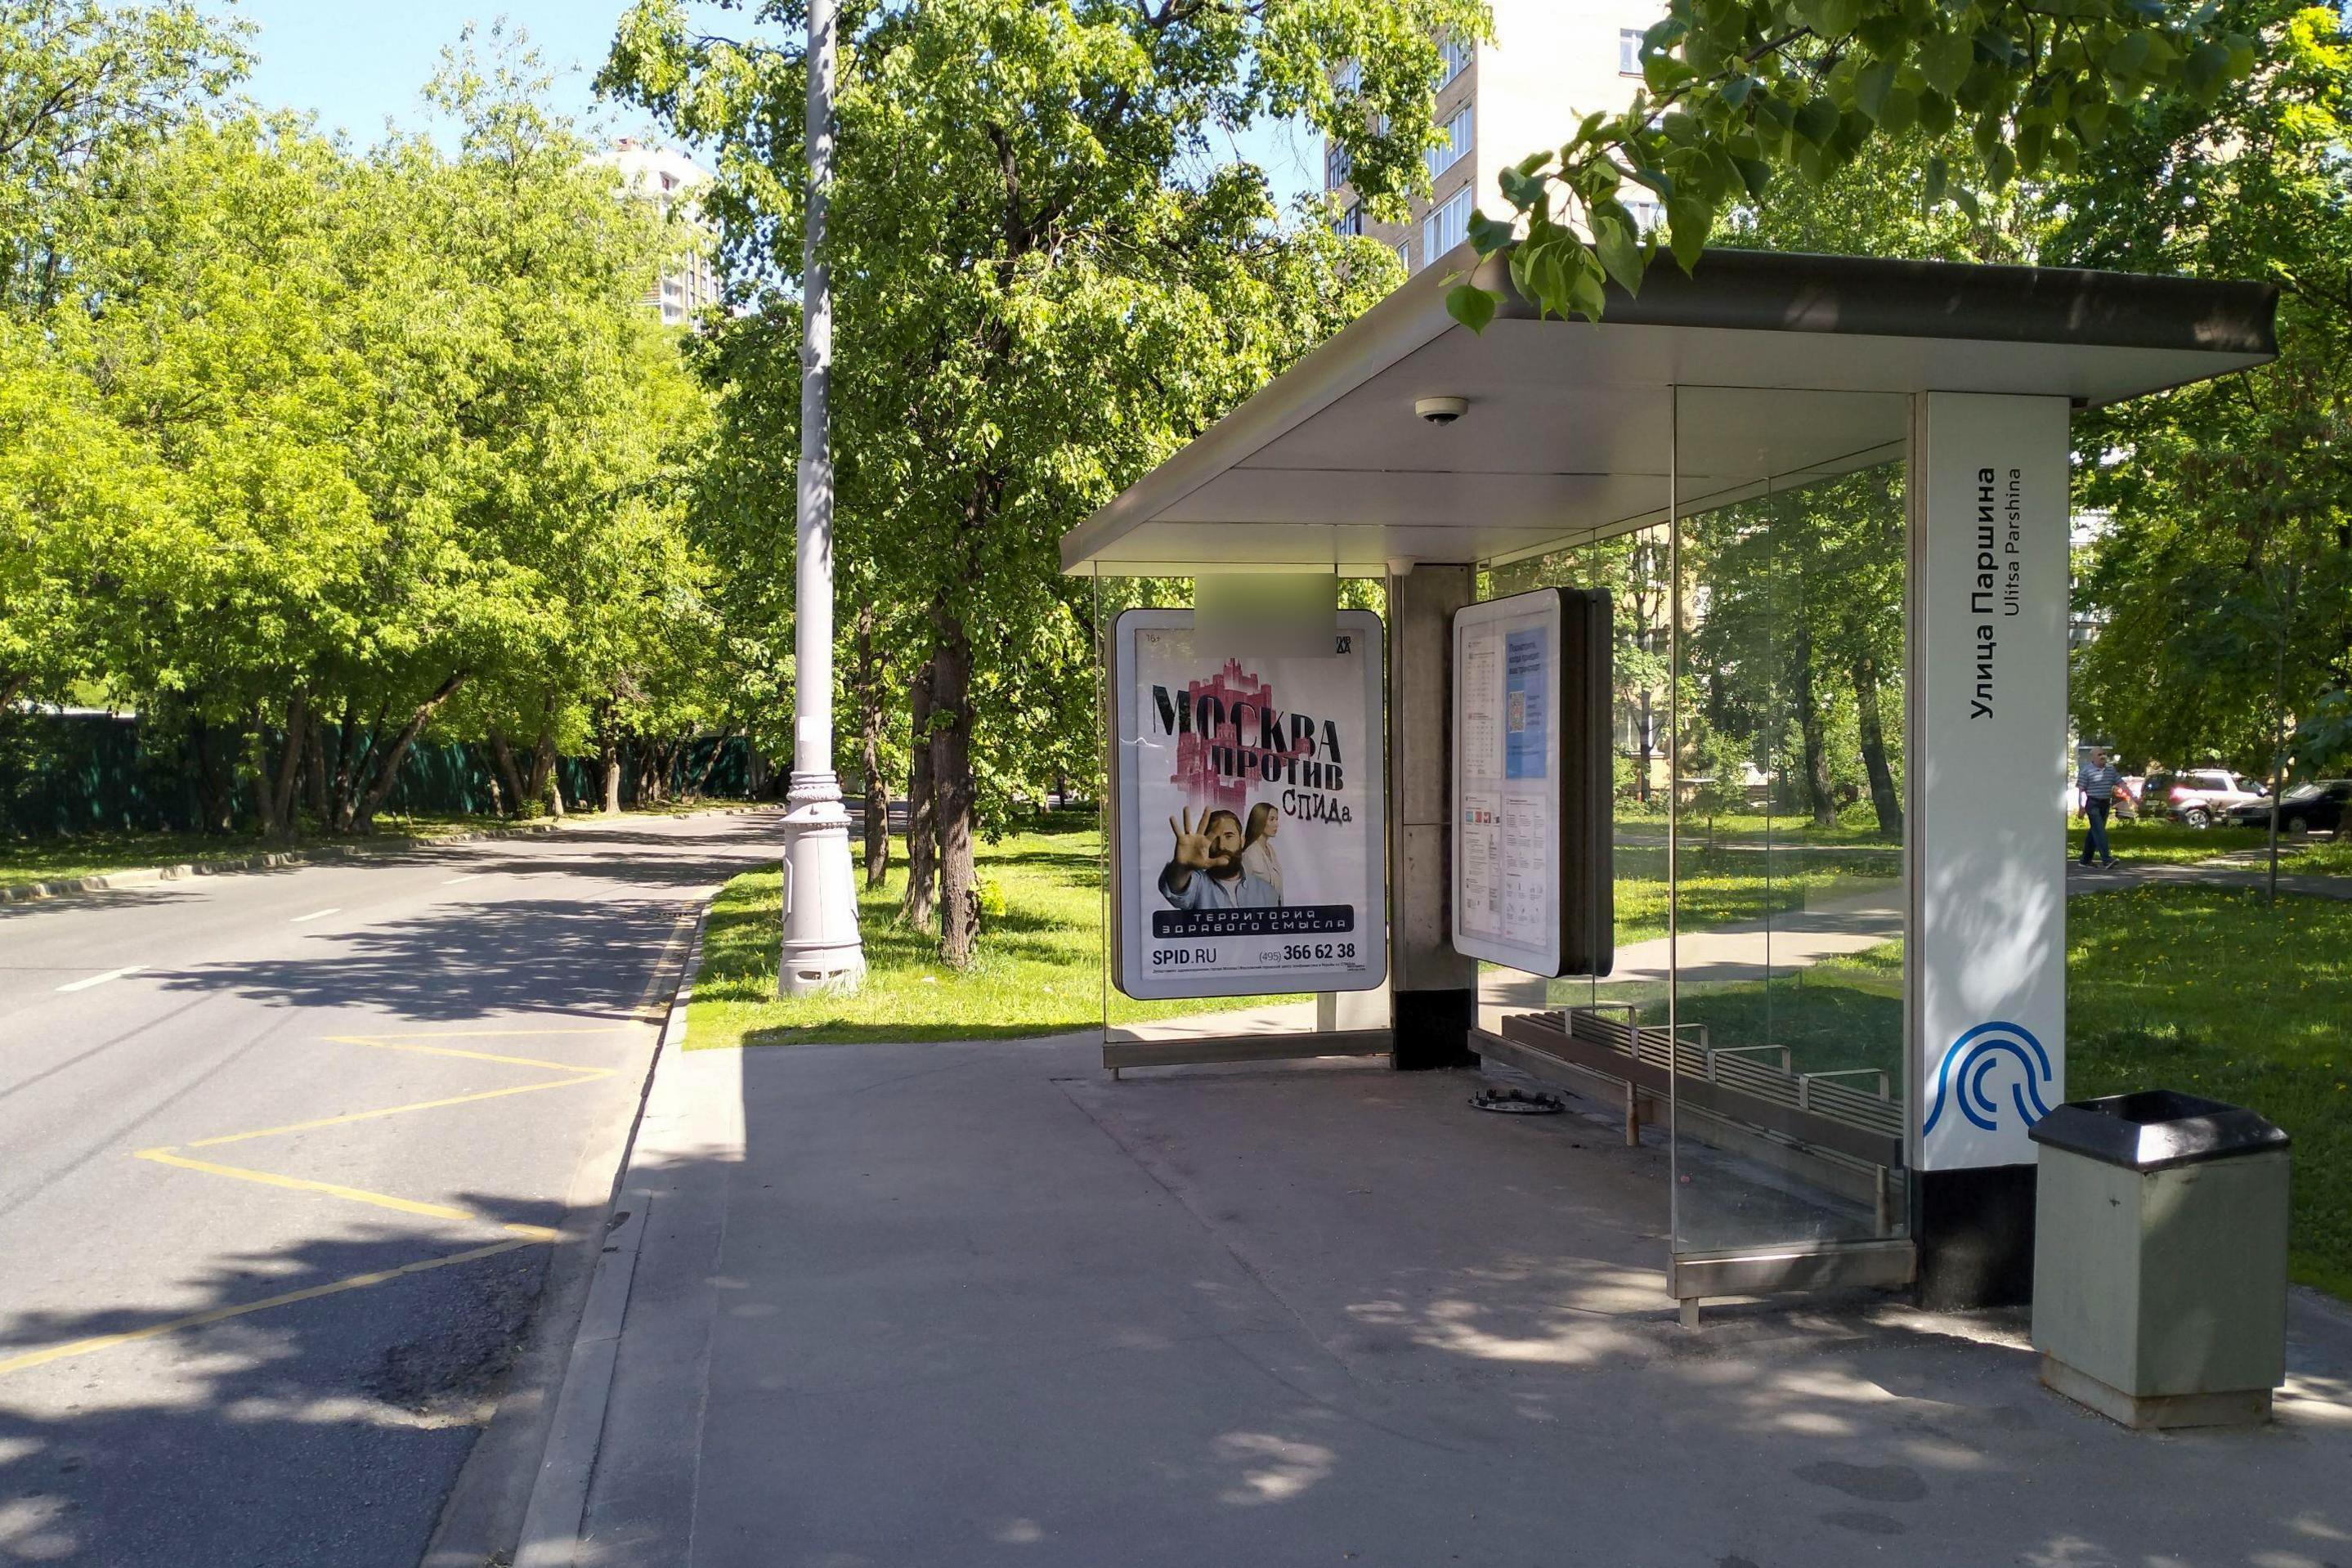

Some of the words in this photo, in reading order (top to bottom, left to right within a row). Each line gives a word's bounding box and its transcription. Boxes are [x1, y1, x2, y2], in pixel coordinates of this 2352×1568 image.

[2005, 468, 2021, 553] Parshina
[1971, 468, 2000, 613] Паршина
[2004, 561, 2020, 616] Ulitsa
[1970, 625, 1997, 719] Улица
[1153, 684, 1342, 764] МОСКВА
[1212, 745, 1344, 791] ПРОТИВ
[1162, 922, 1261, 934] ЗДРАВОГО
[1271, 920, 1346, 931] СМЫСЛА
[1194, 910, 1315, 922] ТЕРРИТОРИЯ
[1152, 948, 1216, 965] SPID.RU
[1259, 952, 1282, 964] (495)
[1284, 944, 1312, 961] 366
[1315, 943, 1333, 959] 62
[1337, 943, 1355, 958] 38
